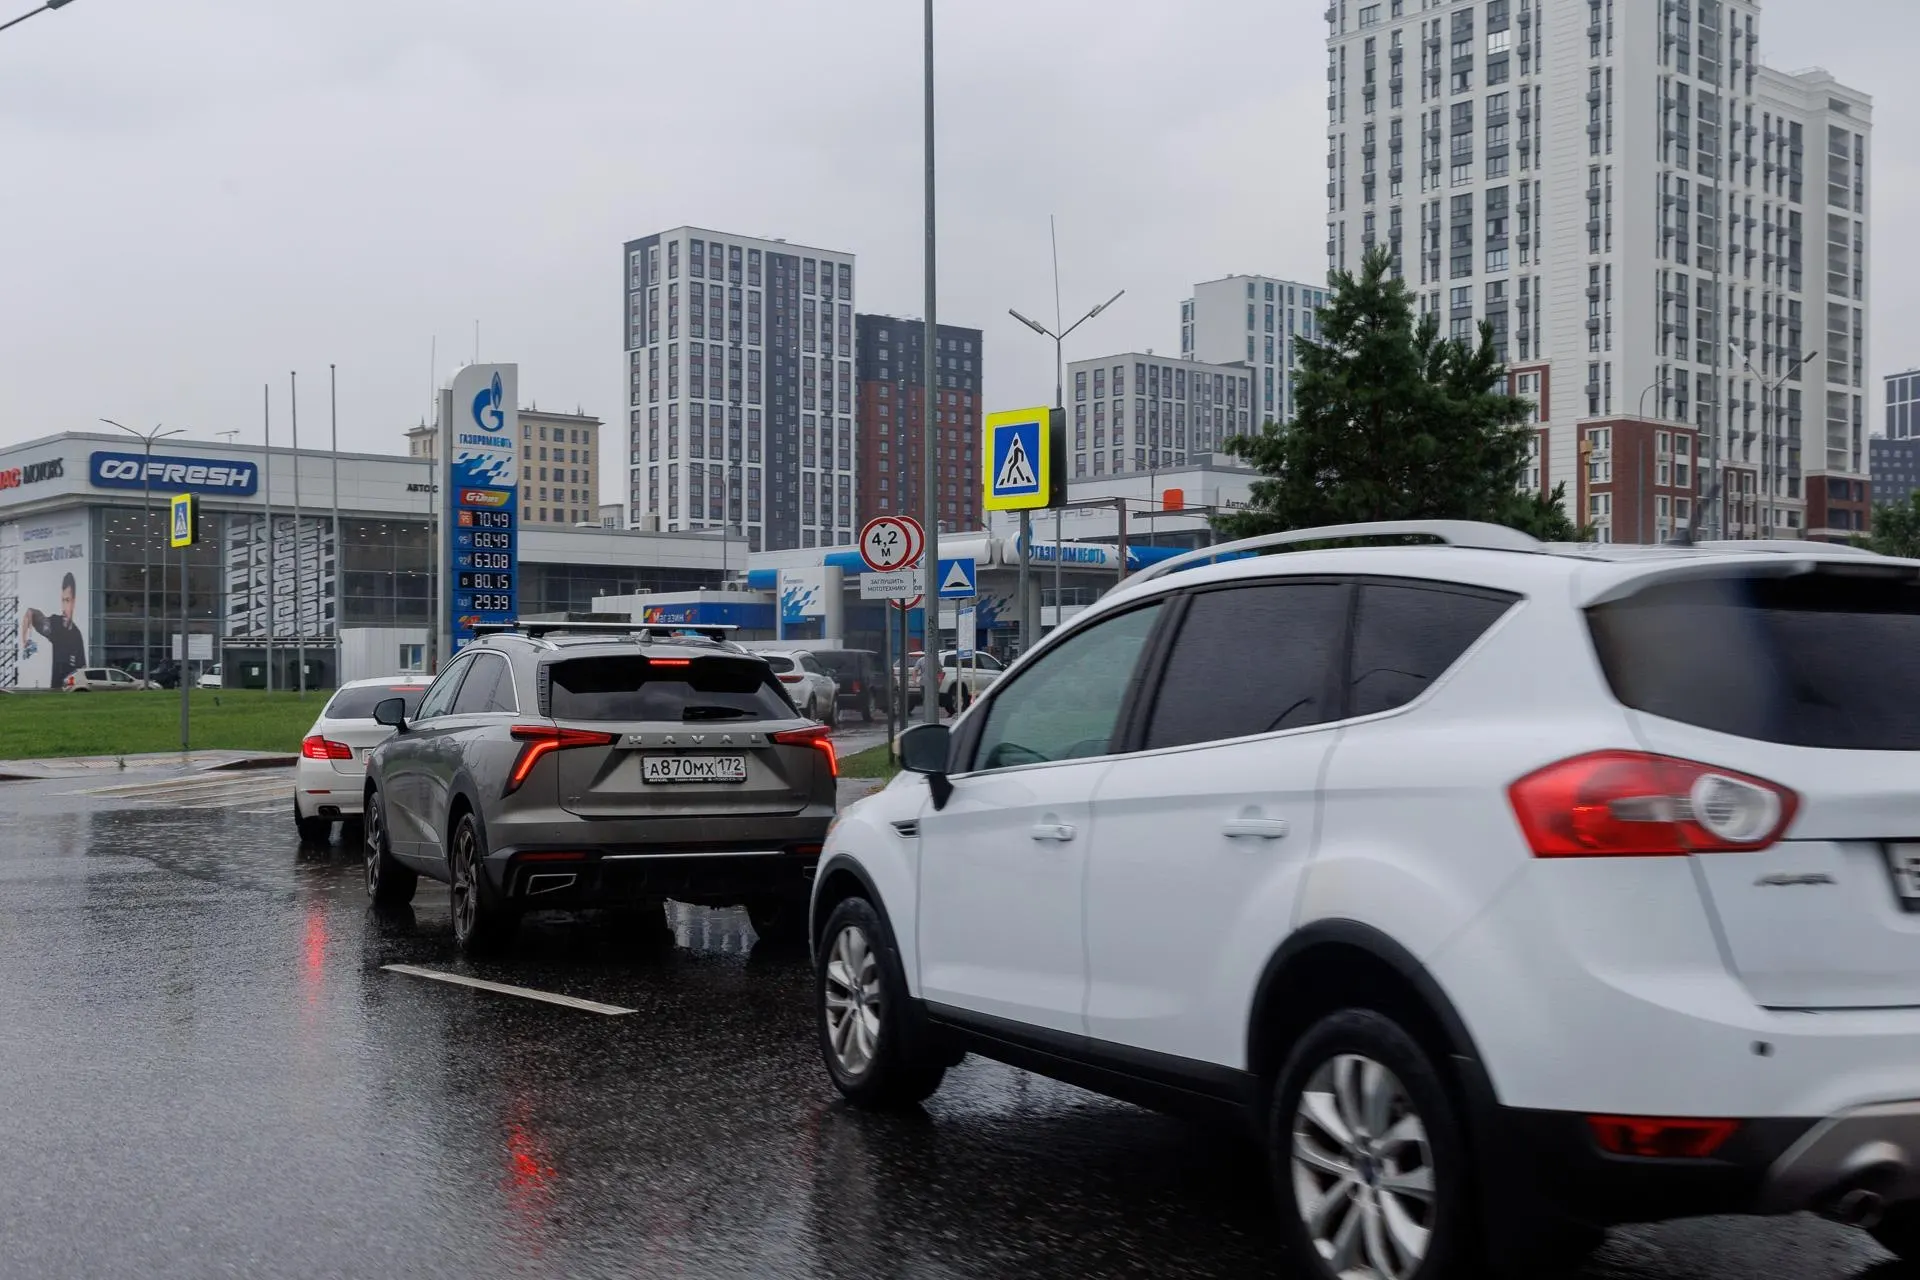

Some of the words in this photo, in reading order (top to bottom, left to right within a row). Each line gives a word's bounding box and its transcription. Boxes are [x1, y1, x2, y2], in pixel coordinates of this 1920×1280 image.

[459, 434, 512, 449] ГАЗПРОМНЕФТЬ
[23, 457, 64, 485] MOTORS
[476, 511, 509, 528] 70.49
[475, 532, 509, 548] 68.49
[872, 530, 898, 548] 4,2
[475, 553, 509, 569] 63.08
[1034, 545, 1106, 564] ГАЗПОМНЕФТЬ
[475, 574, 509, 589] 80.15
[475, 595, 509, 610] 29.39
[629, 735, 761, 744] HAVAL
[717, 759, 742, 771] 172
